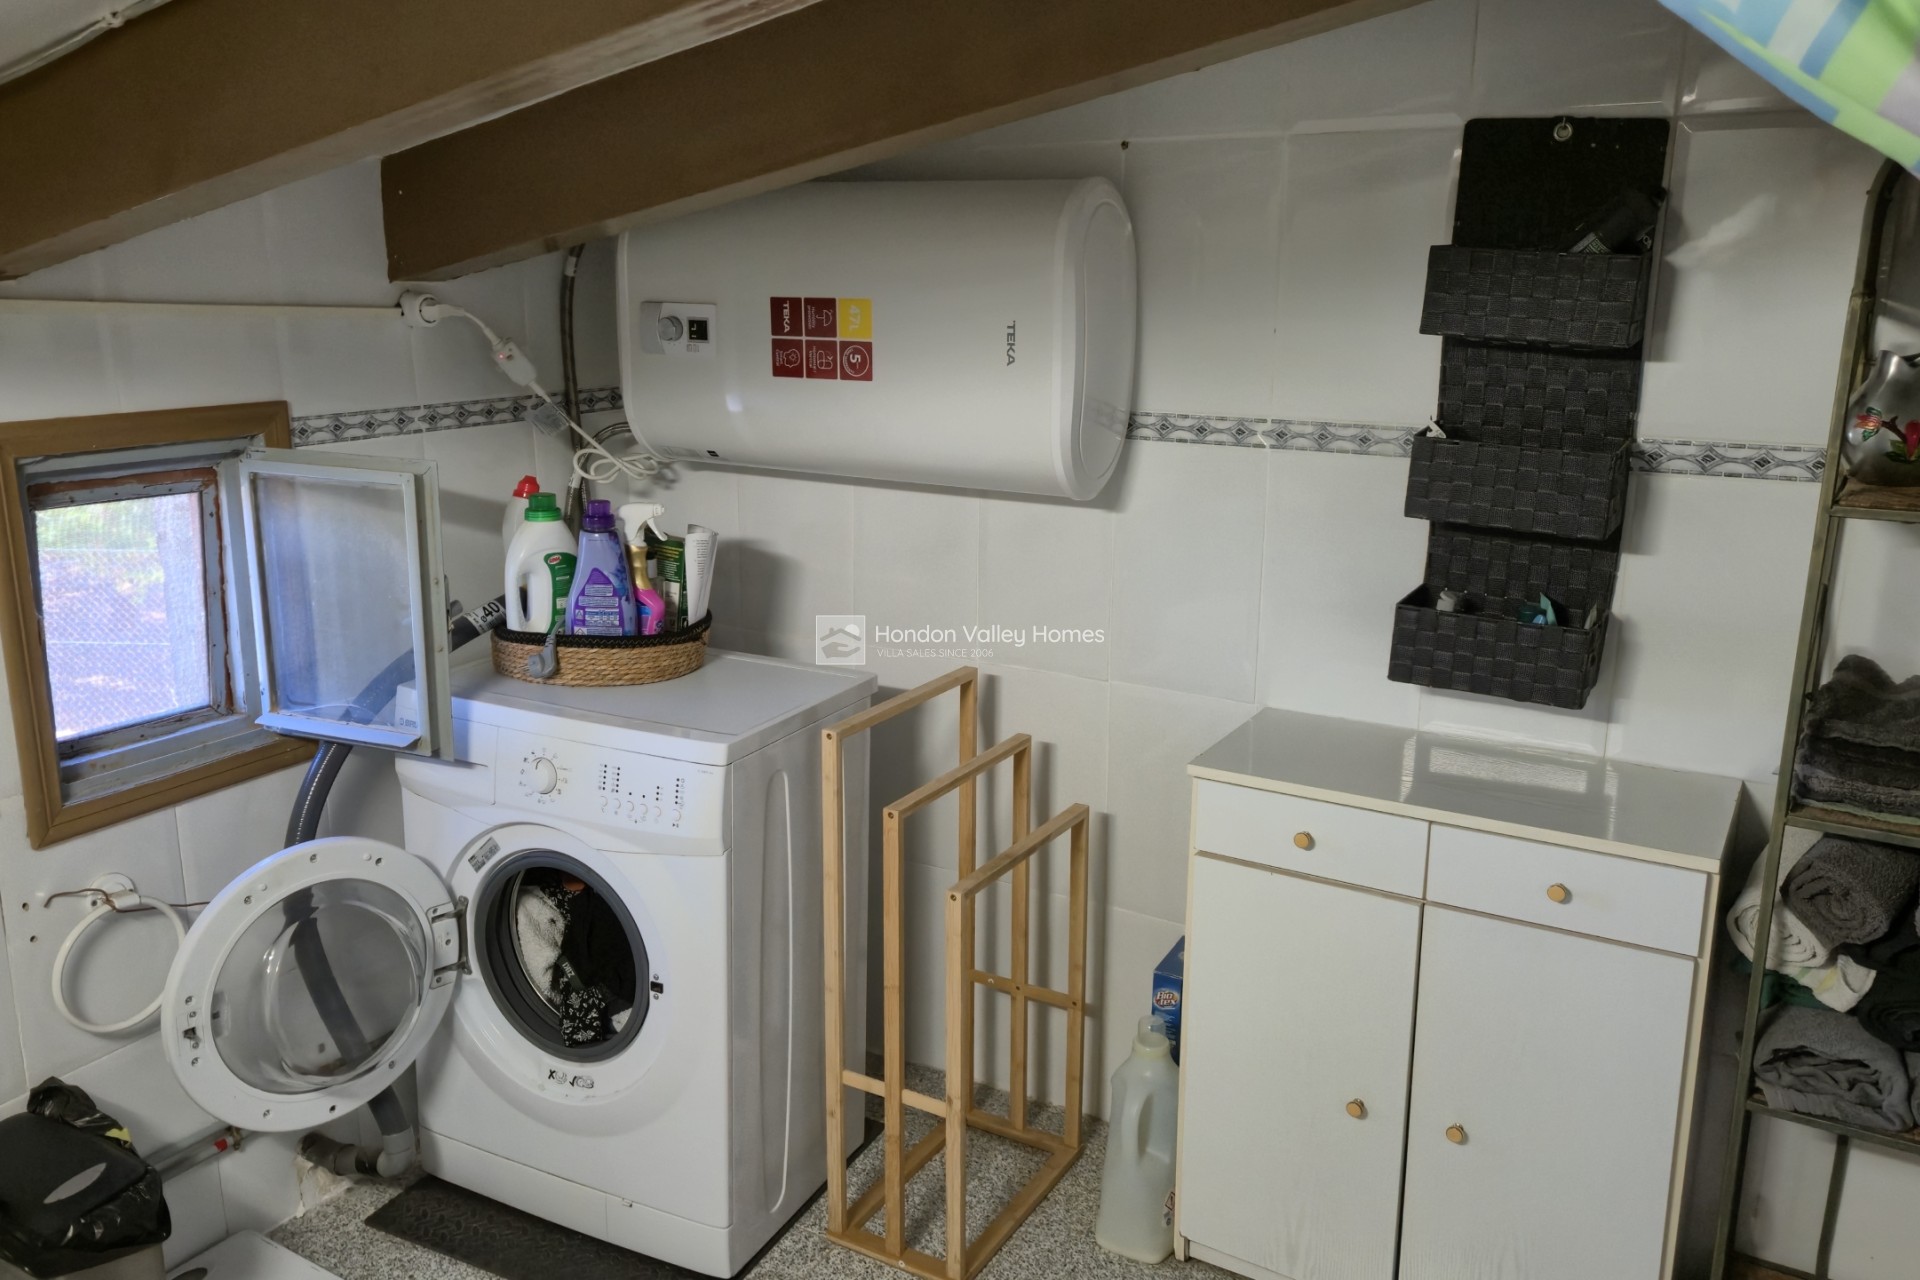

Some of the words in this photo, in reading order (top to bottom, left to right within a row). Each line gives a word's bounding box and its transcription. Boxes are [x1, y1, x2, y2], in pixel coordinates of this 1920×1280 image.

[782, 300, 791, 333] TEKA
[1006, 320, 1016, 367] TEKA
[849, 353, 861, 364] 5
[1156, 991, 1173, 1000] Bio
